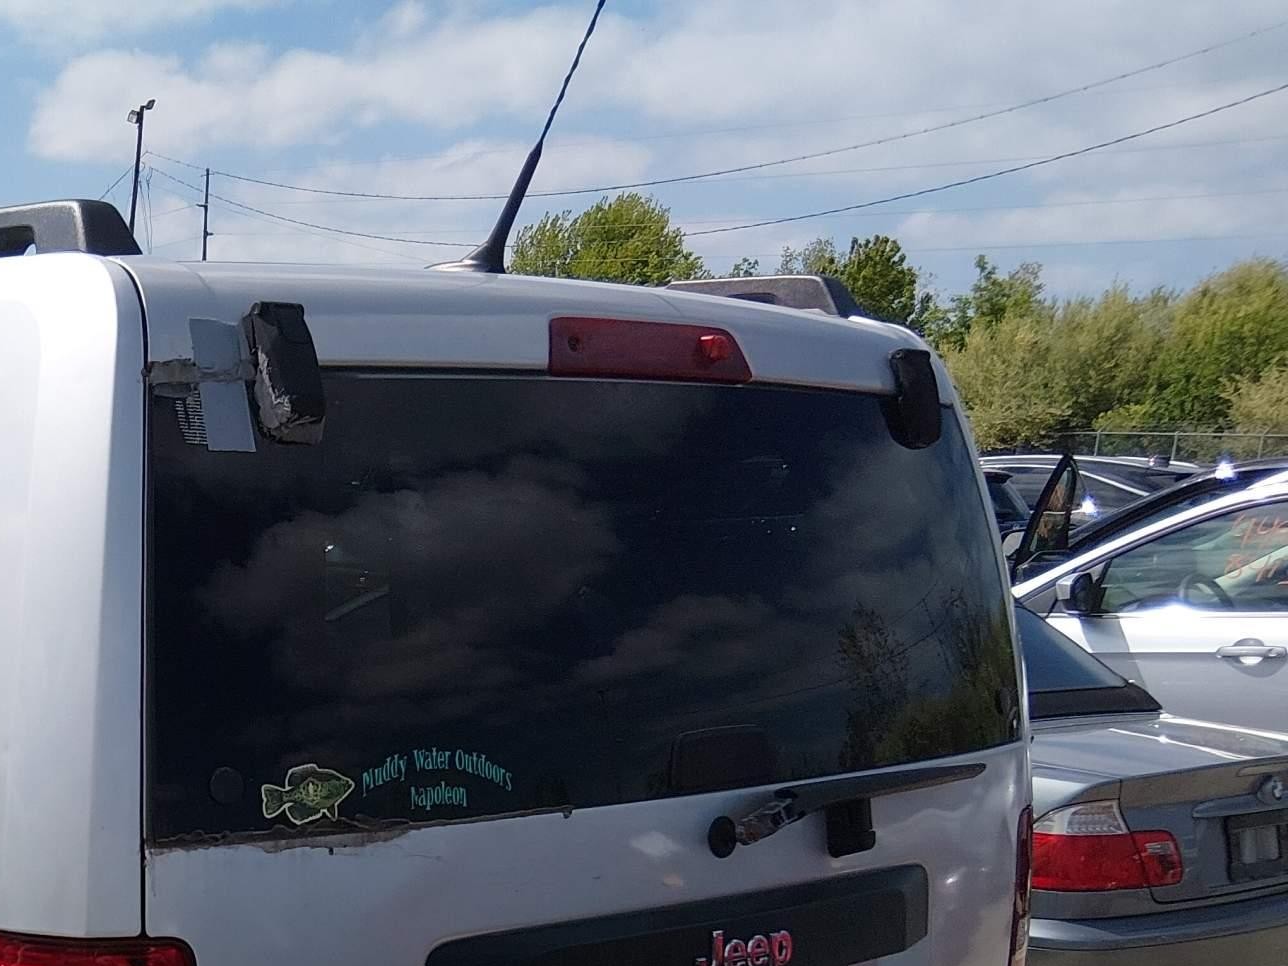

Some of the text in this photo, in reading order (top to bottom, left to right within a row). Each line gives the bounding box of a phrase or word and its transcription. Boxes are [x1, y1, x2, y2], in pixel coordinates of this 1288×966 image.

[361, 747, 513, 798] Muddy Water Outdoors
[410, 780, 468, 811] Napoleon
